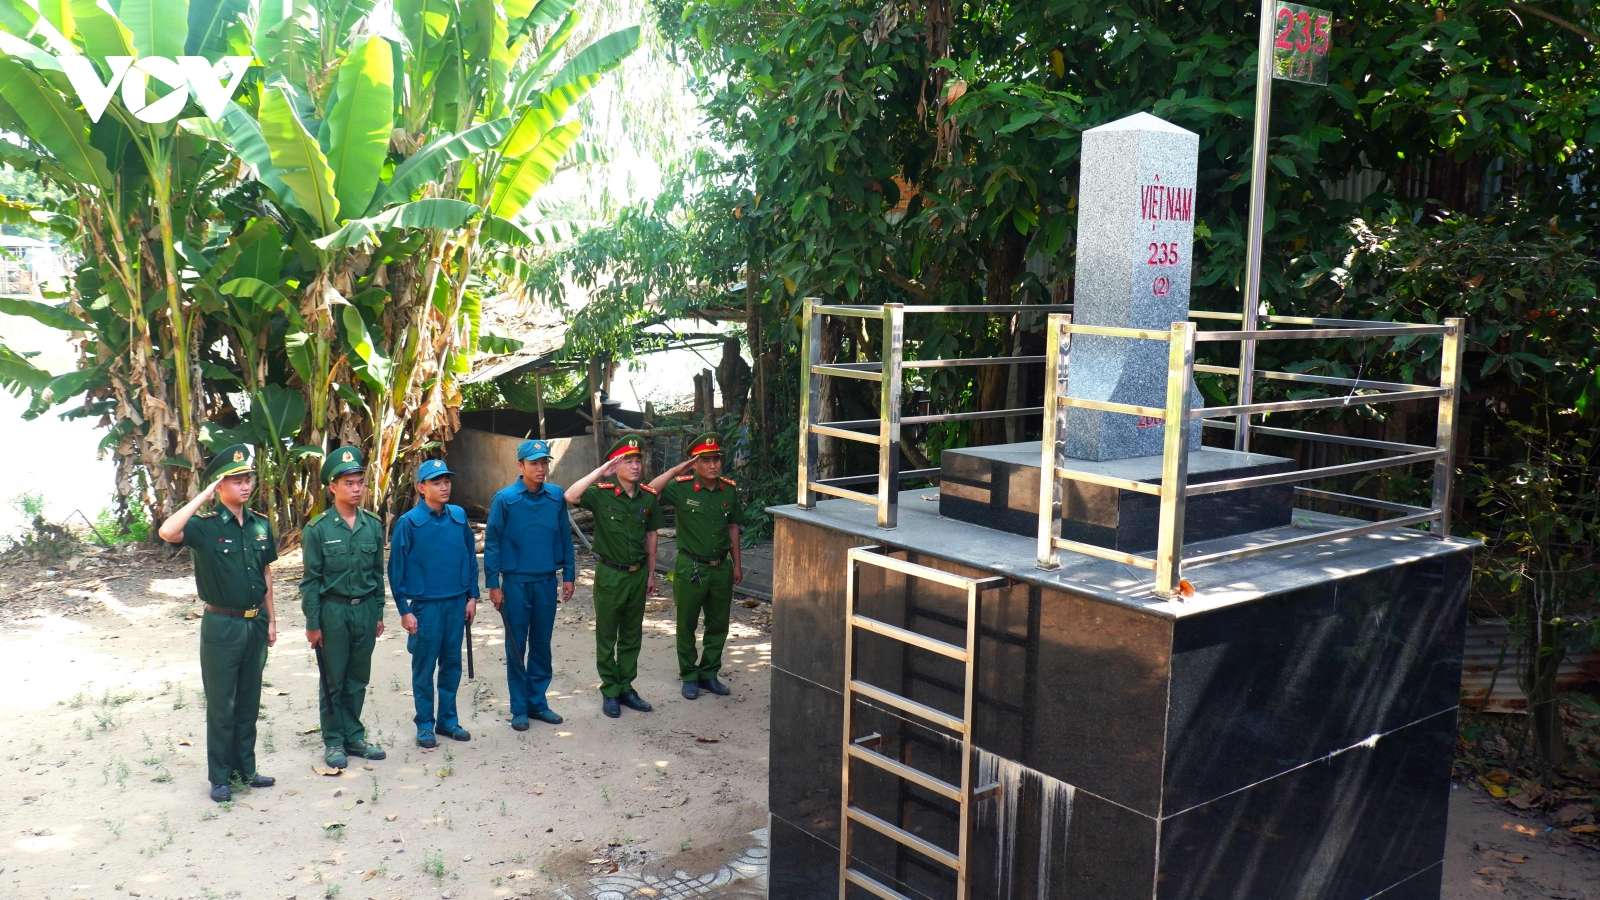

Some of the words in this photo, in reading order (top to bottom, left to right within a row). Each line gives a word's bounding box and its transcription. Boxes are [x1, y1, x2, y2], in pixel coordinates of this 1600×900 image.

[1275, 8, 1329, 56] 235
[1289, 57, 1313, 80] (2)
[1141, 173, 1164, 231] VIỆT
[1165, 186, 1192, 221] NAM
[1147, 242, 1178, 266] 235
[1152, 277, 1170, 296] (2)
